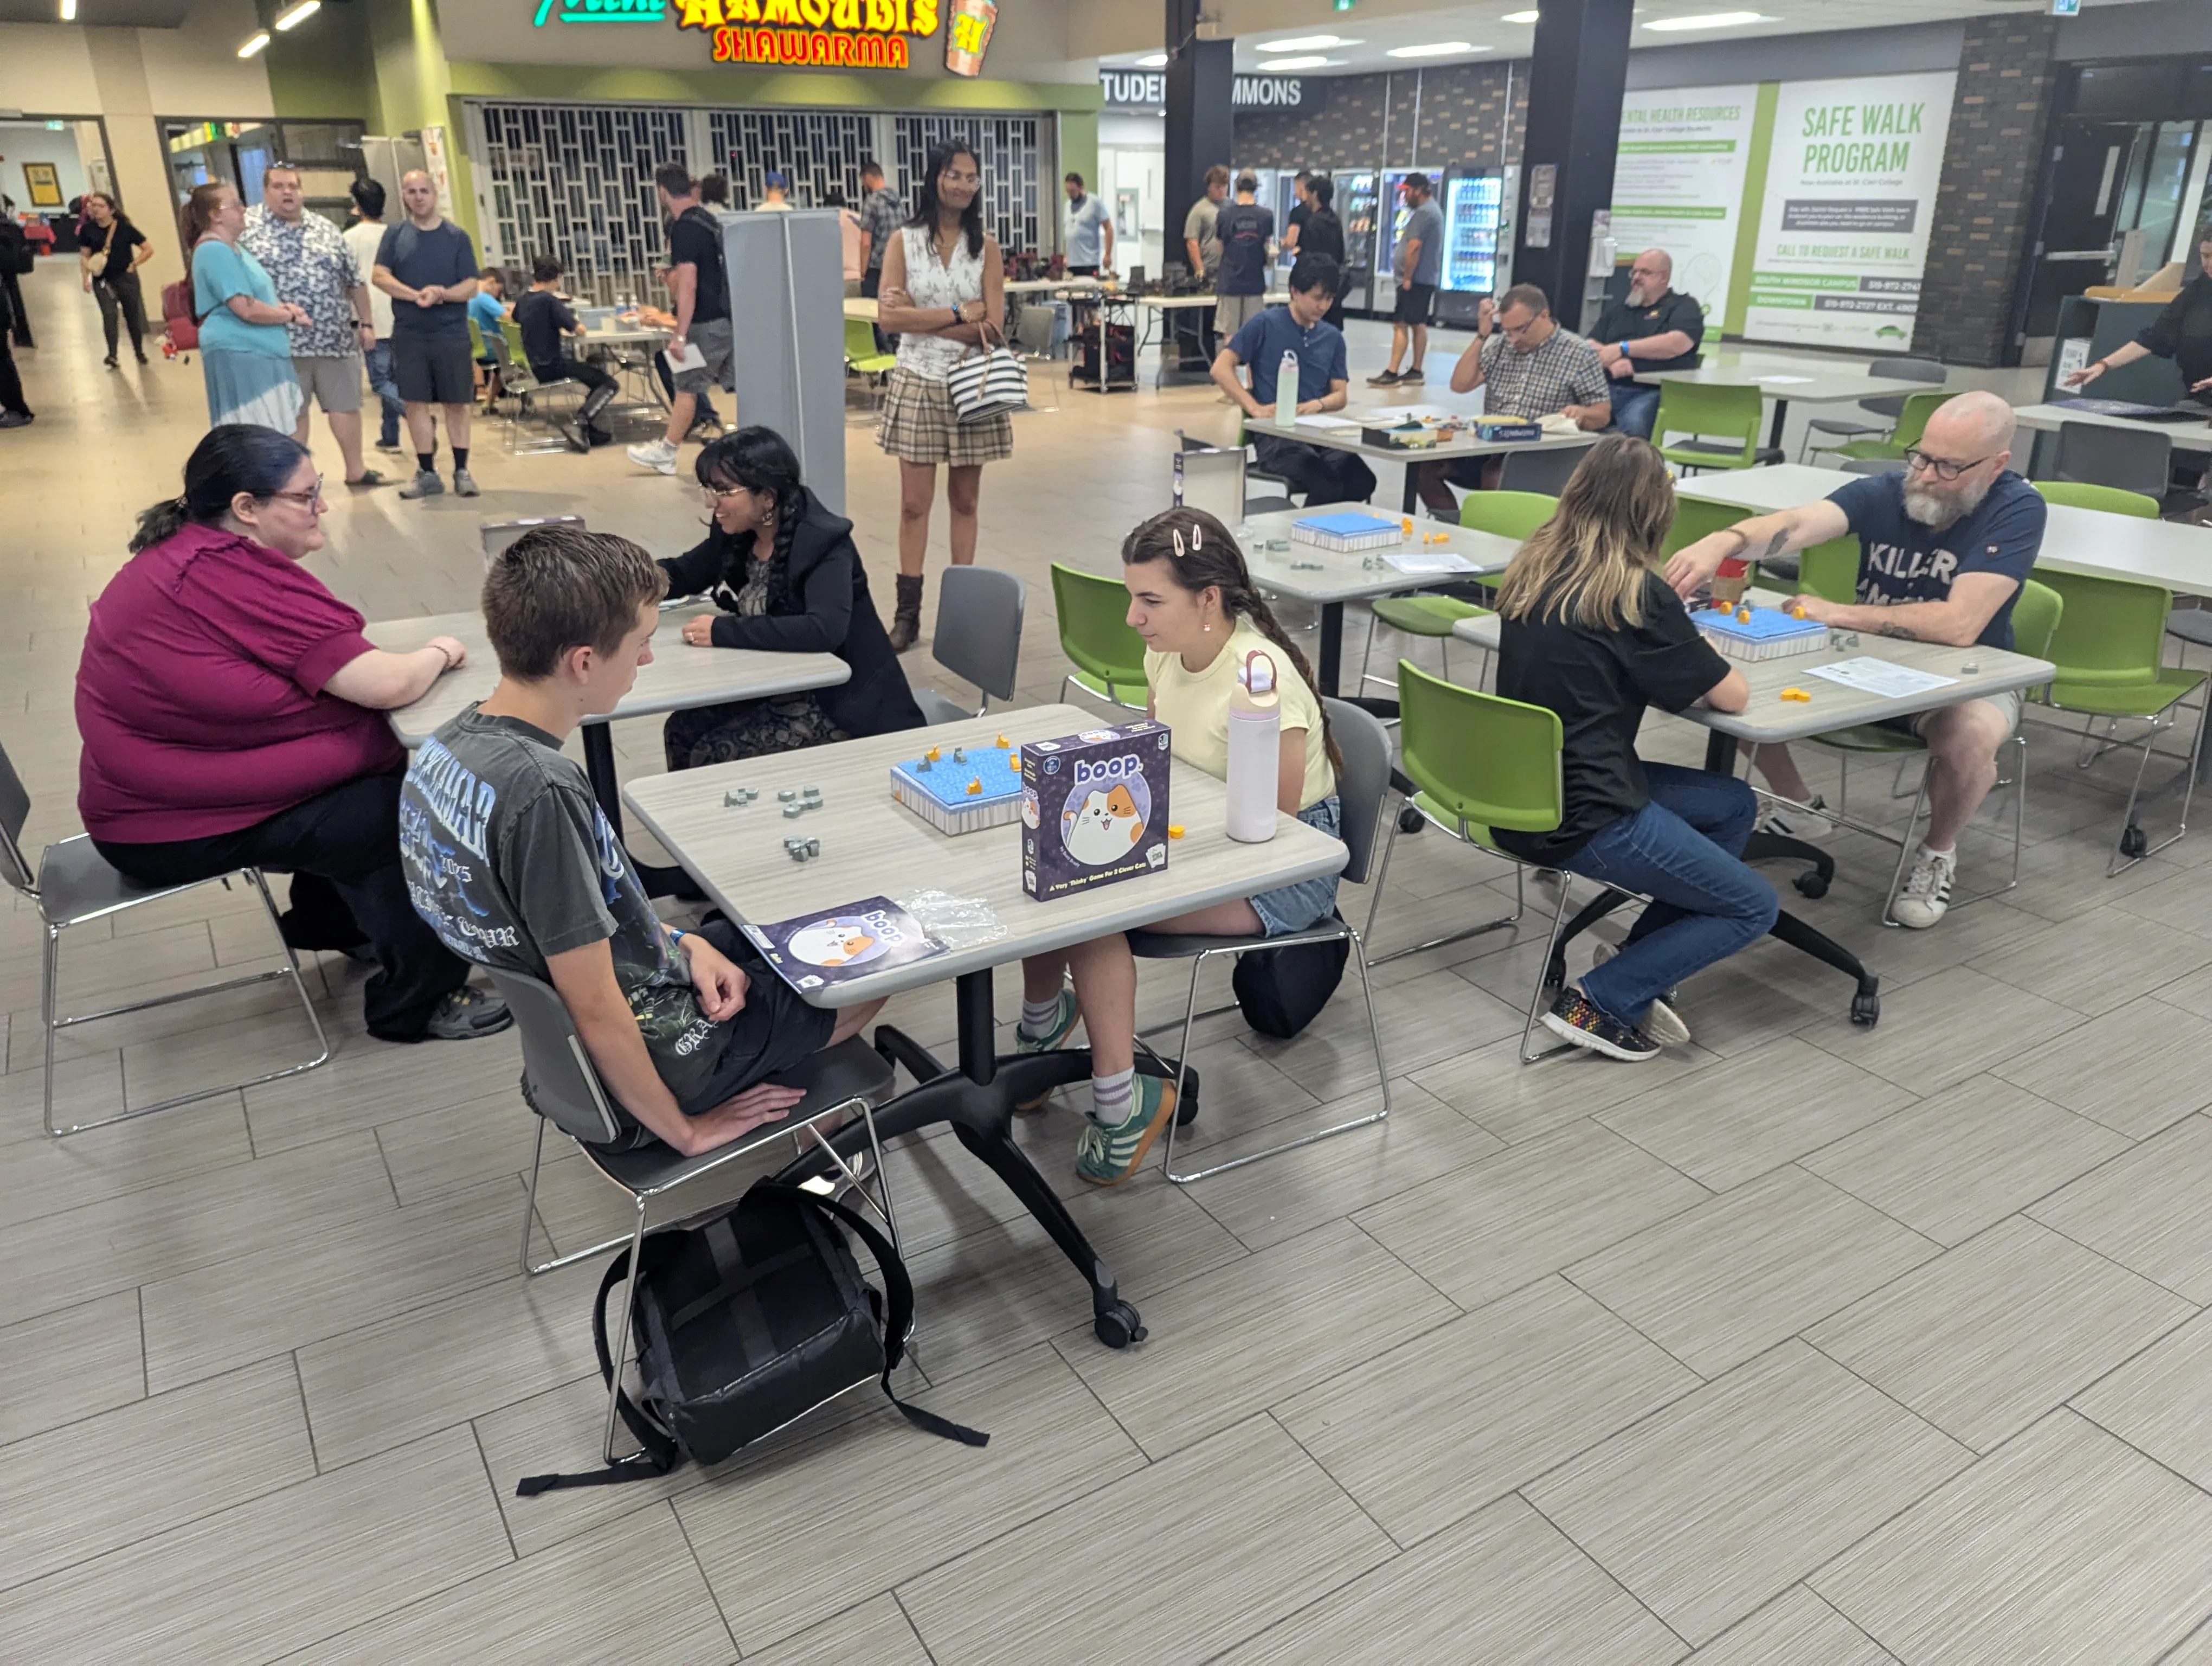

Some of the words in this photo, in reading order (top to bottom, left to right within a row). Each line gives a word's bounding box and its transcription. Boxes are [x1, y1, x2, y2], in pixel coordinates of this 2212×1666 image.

[713, 27, 909, 69] SHAWARMA
[1101, 73, 1166, 101] TUDE
[1232, 78, 1301, 105] MMONS
[1802, 106, 1856, 137] SAFE
[1862, 102, 1926, 135] WALK
[1803, 141, 1911, 174] PROGRAM
[1867, 541, 1958, 585] KILLER
[1089, 873, 1104, 882] Game
